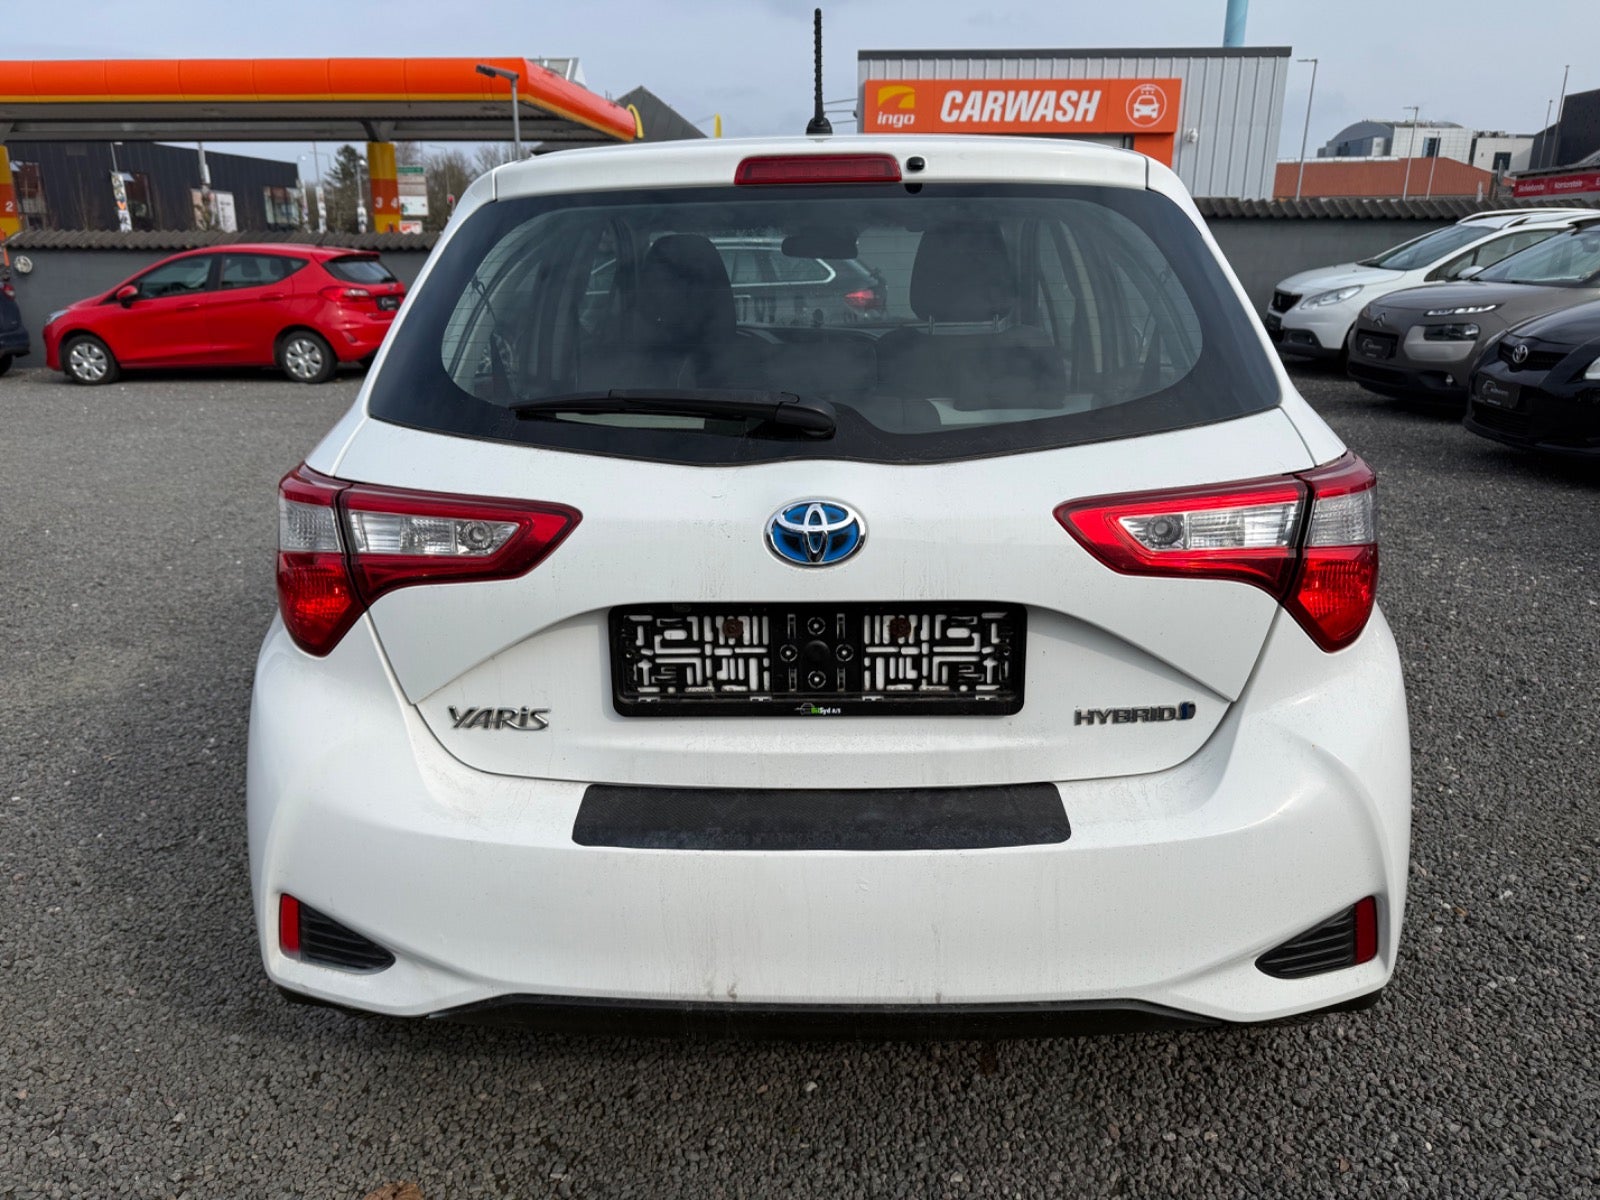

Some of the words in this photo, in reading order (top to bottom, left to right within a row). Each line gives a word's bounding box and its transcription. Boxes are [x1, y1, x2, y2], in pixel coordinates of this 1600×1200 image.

[940, 90, 1102, 122] CARWASH
[877, 111, 915, 128] ingo
[5, 201, 14, 212] 2
[375, 196, 384, 209] 3
[390, 196, 399, 209] 4
[1074, 705, 1177, 727] HYBRID
